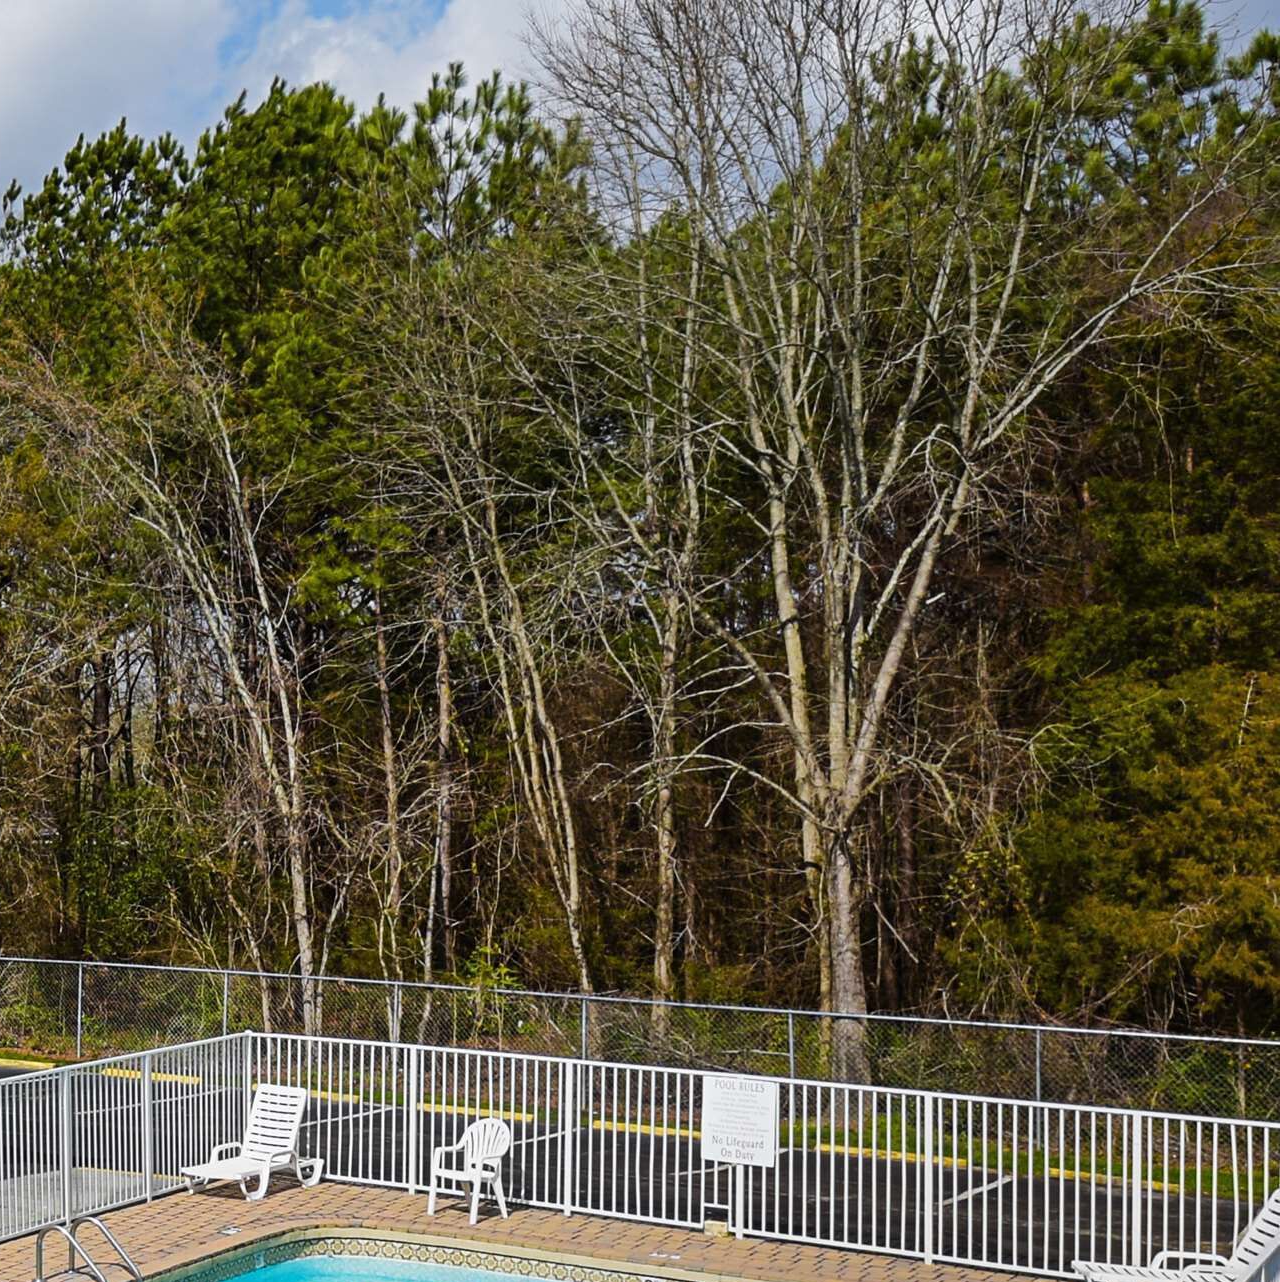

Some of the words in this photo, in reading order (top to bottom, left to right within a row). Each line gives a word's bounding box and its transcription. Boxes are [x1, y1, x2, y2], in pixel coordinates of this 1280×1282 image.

[714, 1079, 736, 1090] POOL
[739, 1081, 765, 1093] RULES
[712, 1135, 723, 1145] No
[726, 1136, 764, 1150] Lifeguard
[721, 1147, 733, 1158] On
[735, 1149, 756, 1161] Duty
